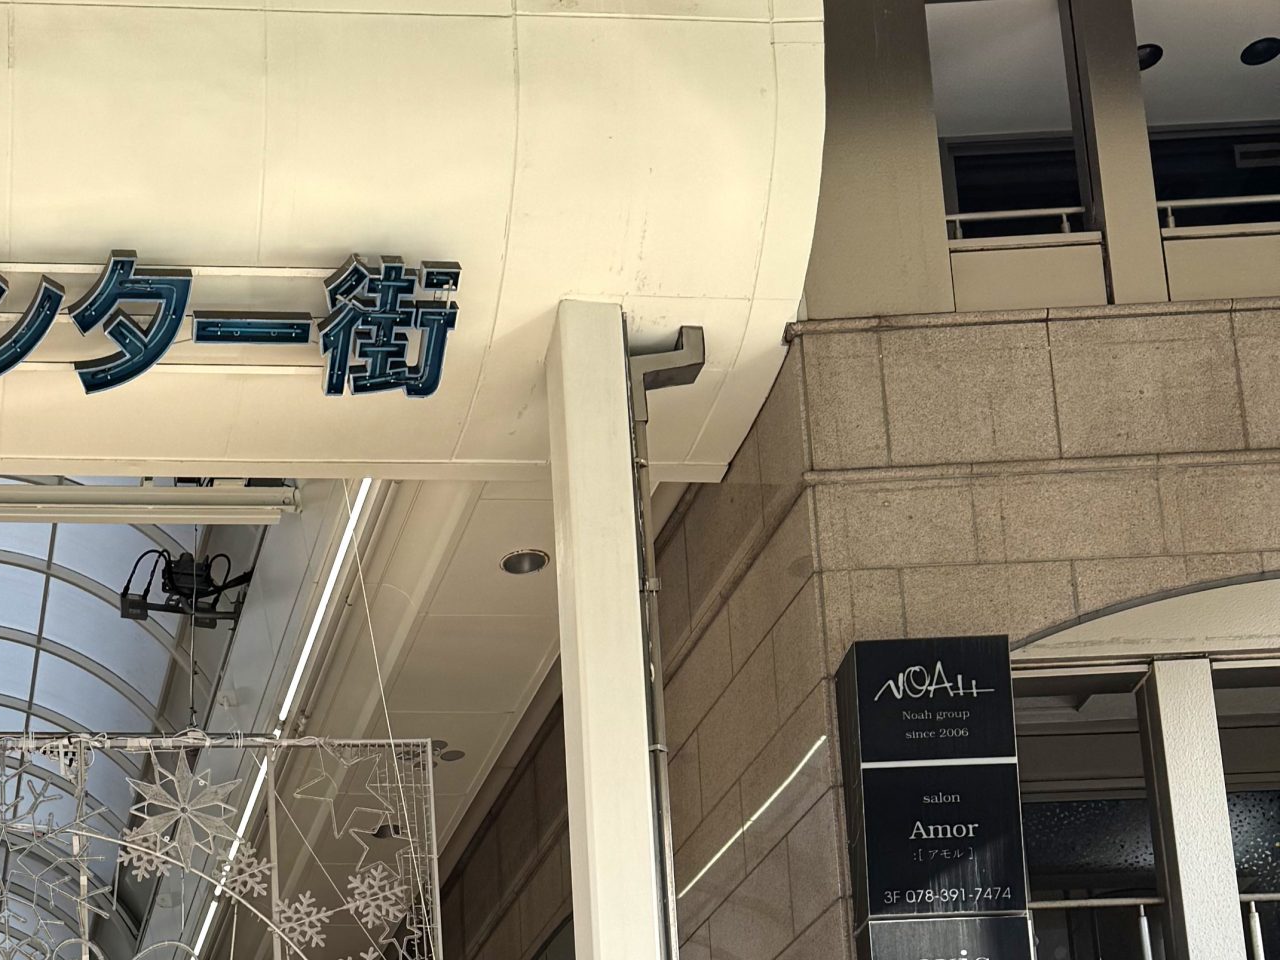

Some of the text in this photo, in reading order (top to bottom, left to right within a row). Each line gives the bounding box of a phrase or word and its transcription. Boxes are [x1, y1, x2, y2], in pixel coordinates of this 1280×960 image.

[902, 710, 970, 721] Noah group
[905, 727, 969, 739] since 2006
[922, 792, 961, 804] salon
[908, 820, 979, 840] Amor
[884, 887, 1012, 904] 3F 078-391-7474
